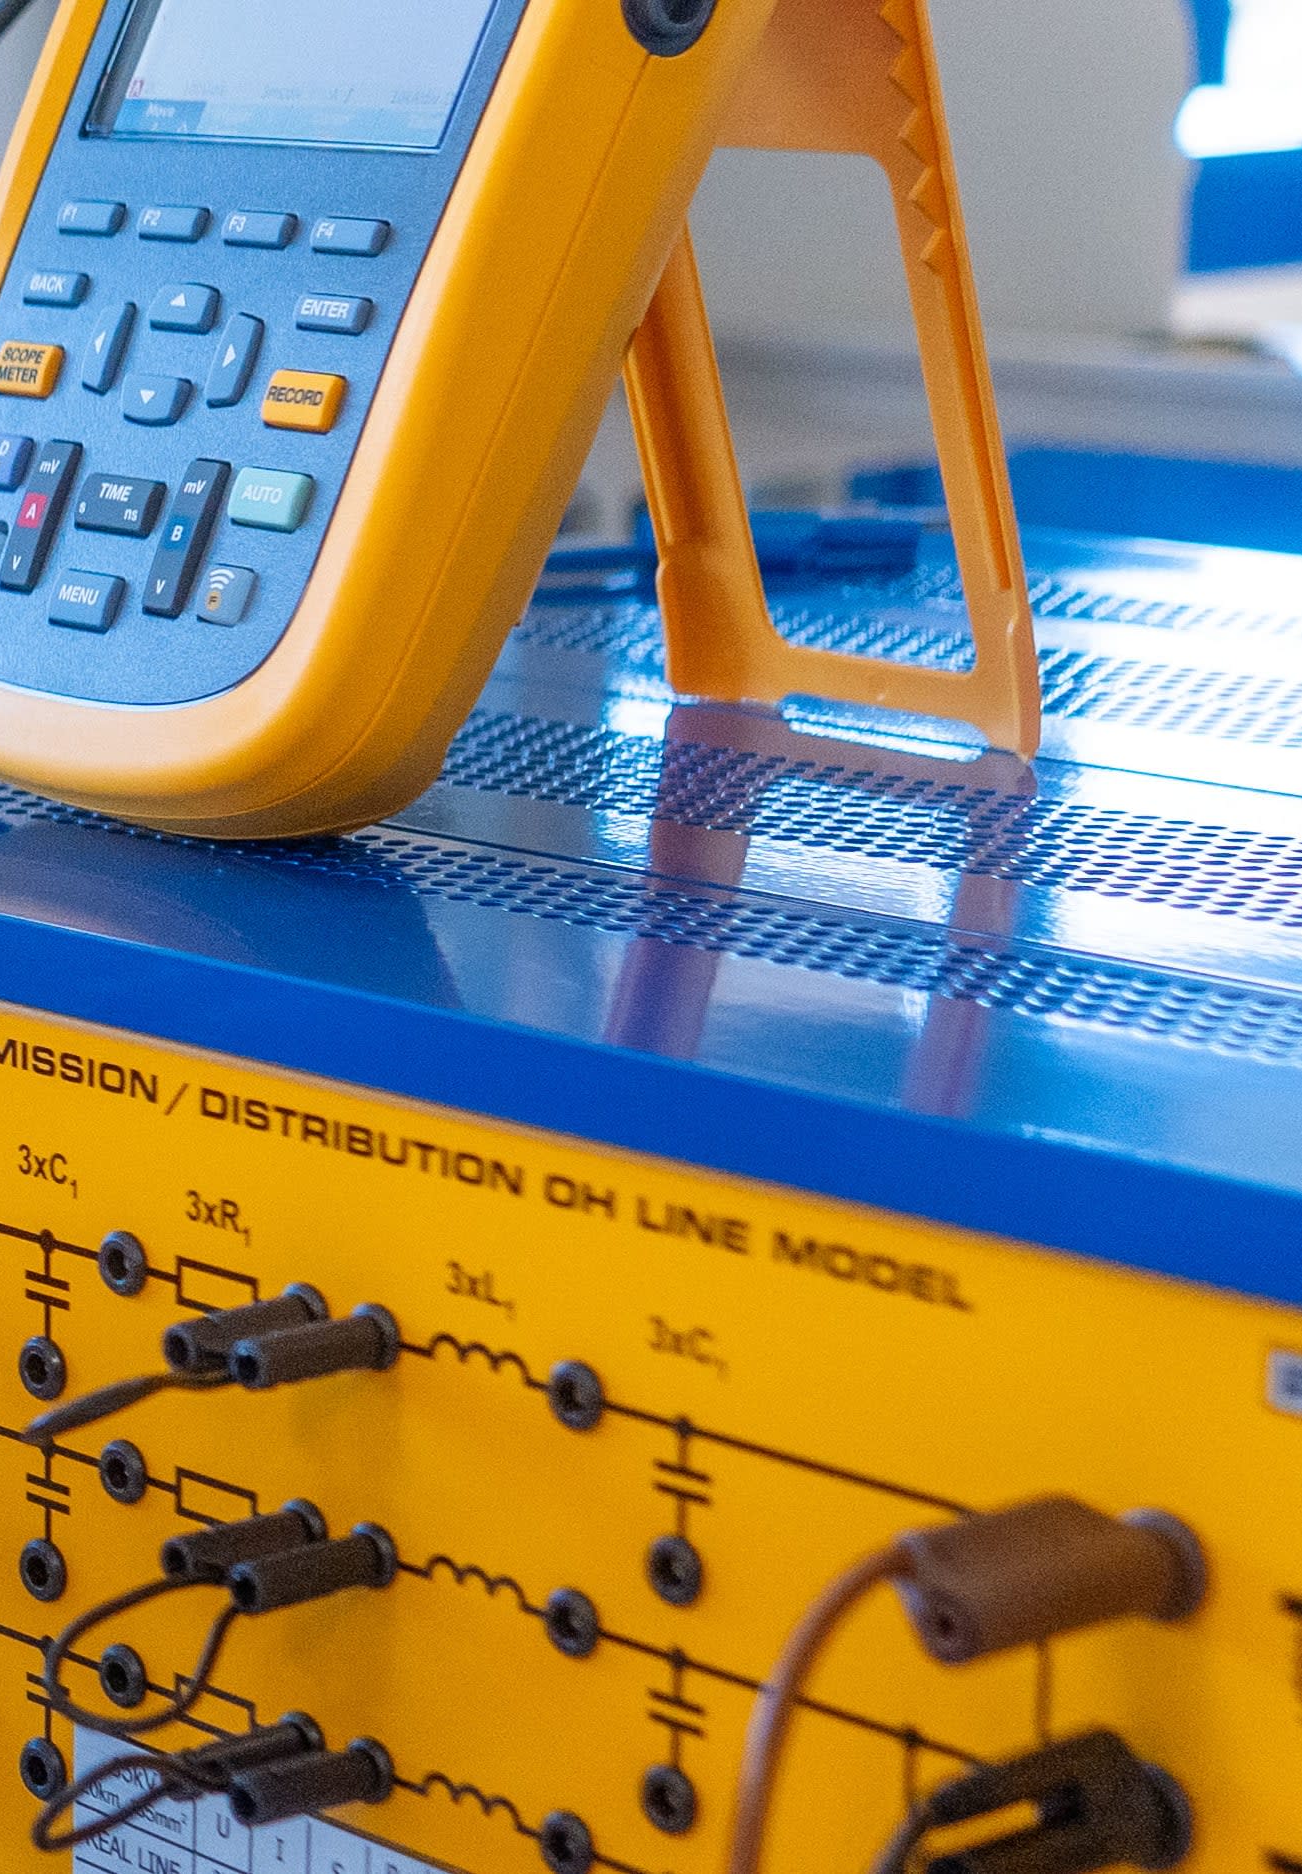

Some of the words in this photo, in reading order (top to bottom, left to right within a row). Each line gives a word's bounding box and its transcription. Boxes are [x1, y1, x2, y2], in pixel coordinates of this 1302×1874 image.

[62, 207, 77, 221] F1
[143, 210, 160, 226] F2
[228, 215, 246, 233] F3
[316, 222, 334, 239] F4
[30, 274, 65, 293] BACK
[300, 299, 349, 319] ENTER
[2, 346, 45, 365] SCOPE
[266, 385, 324, 407] RECORD
[40, 459, 60, 474] mV
[99, 483, 133, 502] TIME
[184, 479, 207, 495] mV
[241, 484, 283, 505] AUTO
[26, 503, 37, 520] A
[124, 508, 139, 522] ns
[171, 525, 184, 542] B
[12, 555, 21, 571] V
[58, 584, 100, 606] MENU
[155, 579, 166, 594] V
[200, 1086, 524, 1197] DISTRIBUTION
[543, 1172, 617, 1221] OH
[635, 1196, 751, 1257] LINE
[770, 1228, 974, 1315] MODEL
